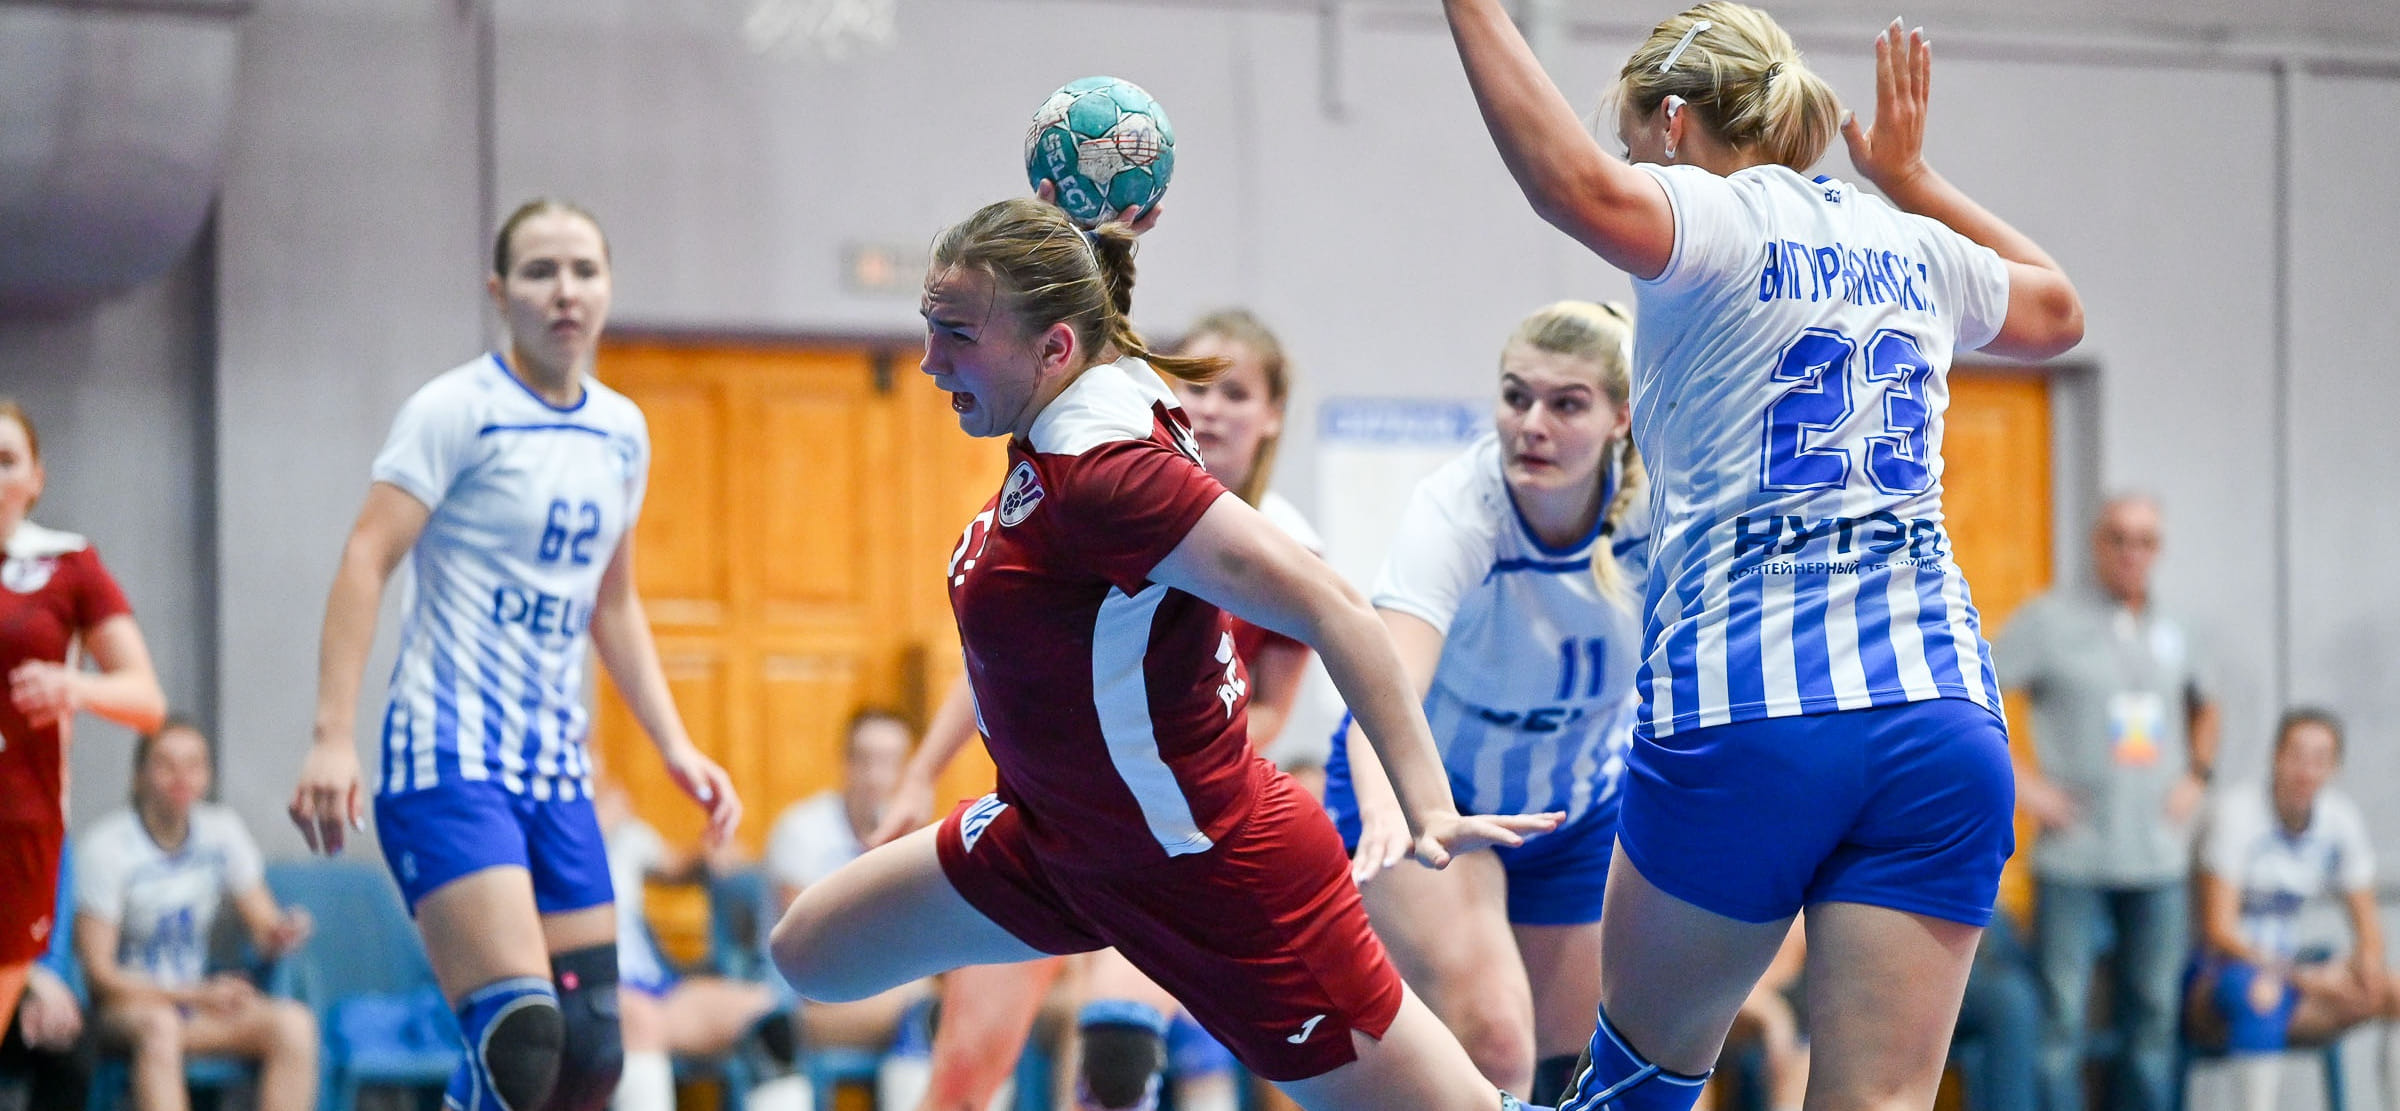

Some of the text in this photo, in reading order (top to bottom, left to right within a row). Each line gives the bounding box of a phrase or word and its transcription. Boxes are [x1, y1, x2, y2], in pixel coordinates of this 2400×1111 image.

[1042, 133, 1097, 212] SELECT
[1759, 327, 1936, 497] 23
[537, 499, 601, 567] 62
[1734, 510, 1945, 559] НУТЭП
[1727, 559, 1860, 582] КОНТЕЙНЕРНЫЙ
[1555, 636, 1607, 700] 11
